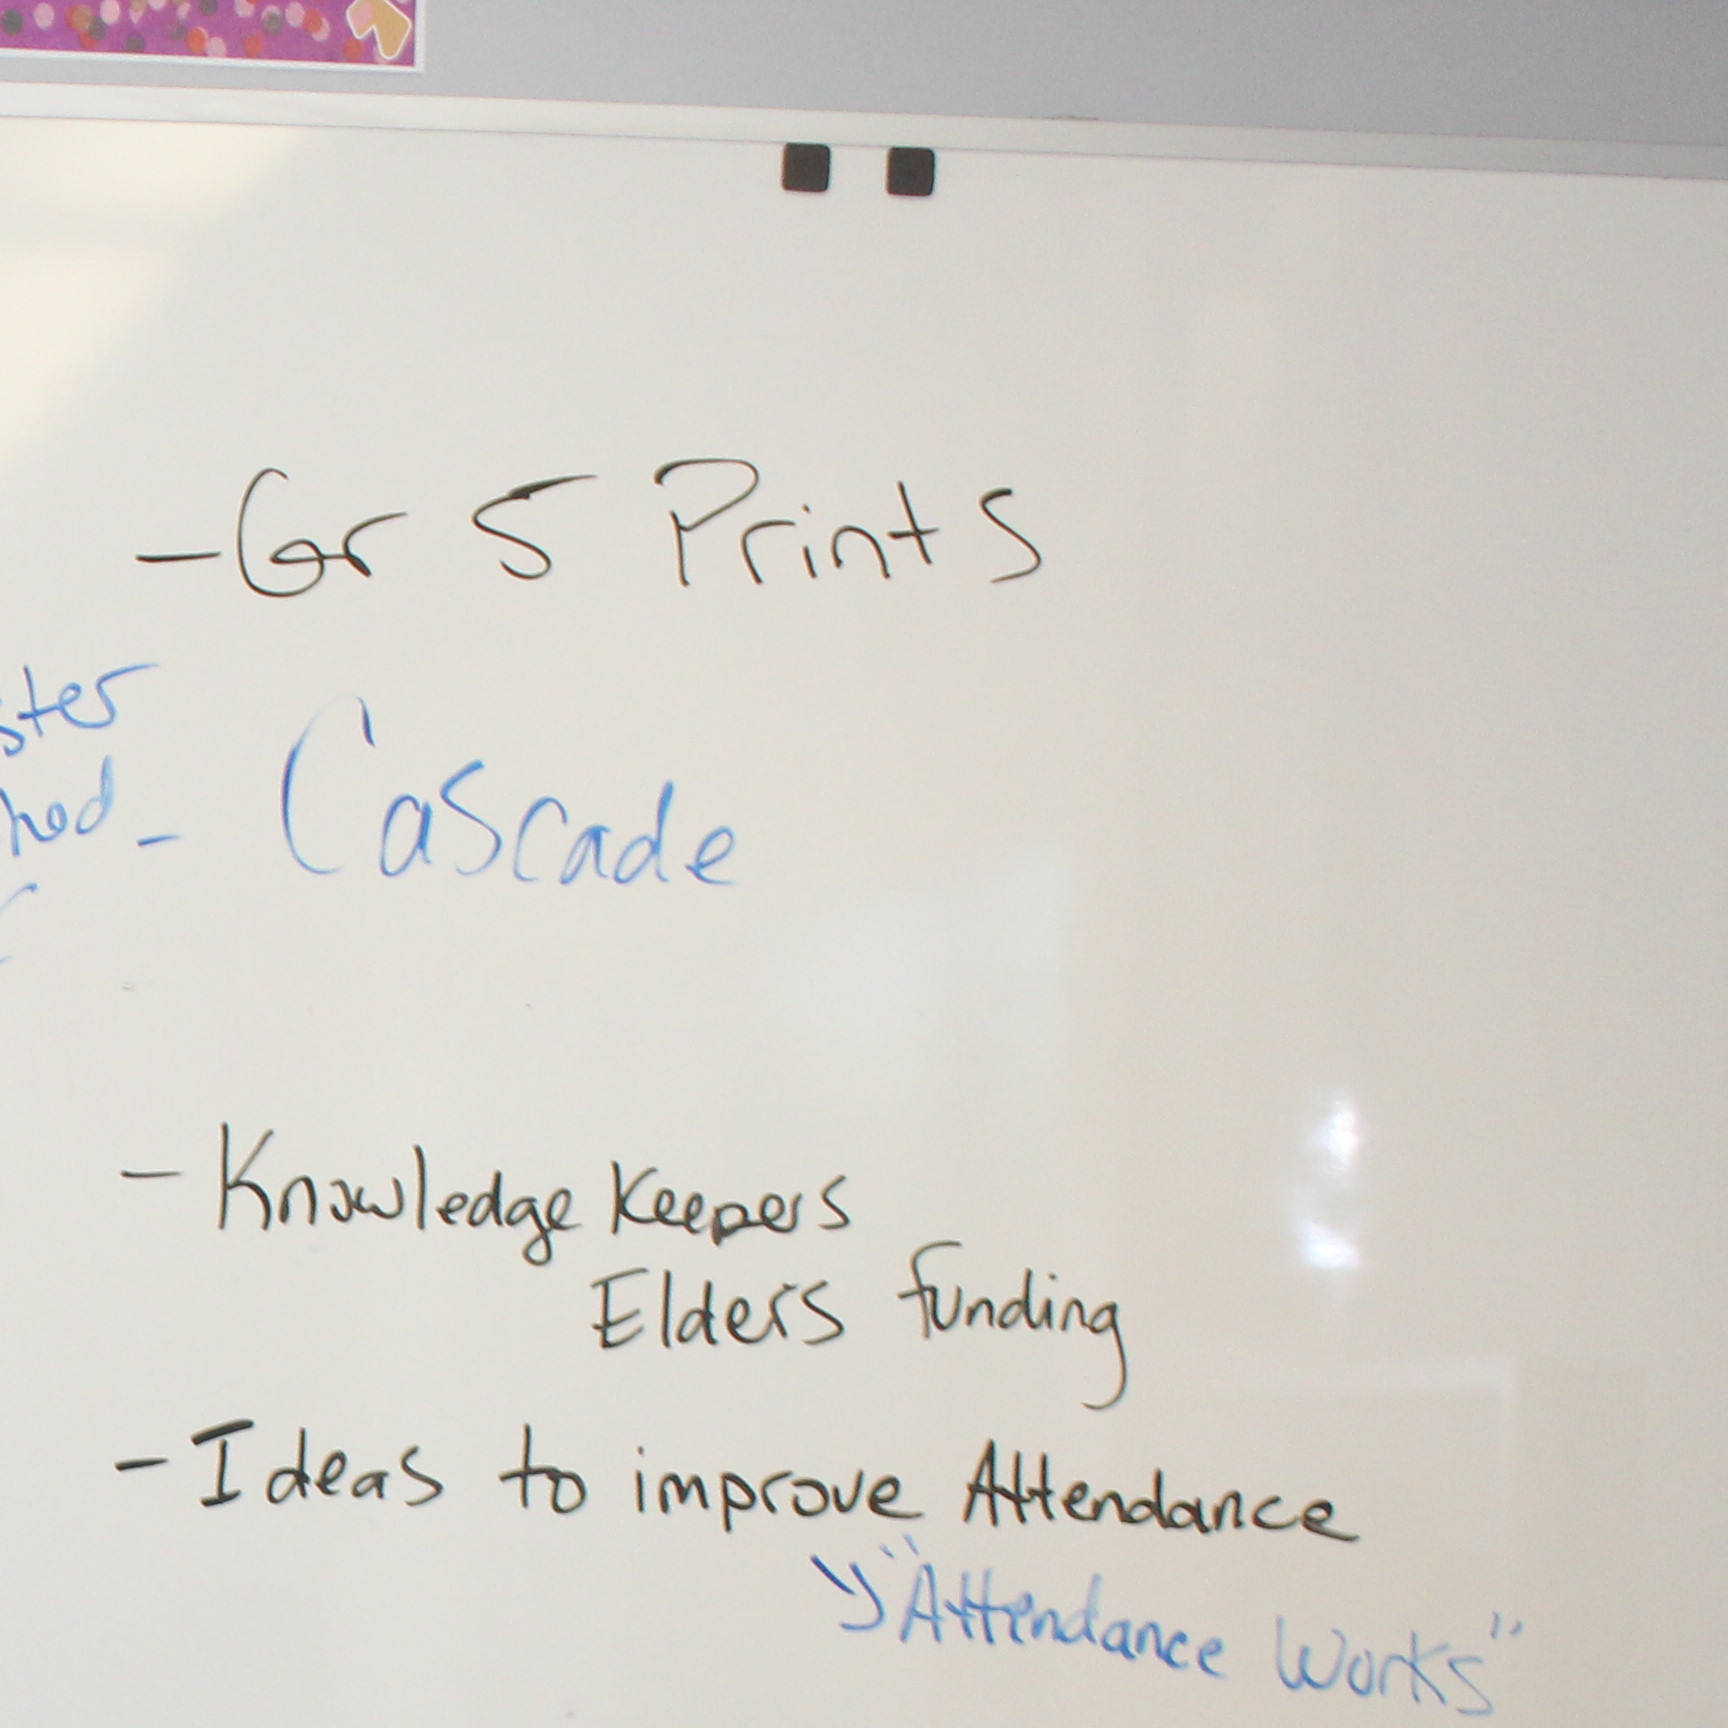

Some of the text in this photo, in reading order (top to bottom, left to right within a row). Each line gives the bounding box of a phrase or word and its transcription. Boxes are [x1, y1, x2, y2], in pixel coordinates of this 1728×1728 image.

[472, 476, 597, 579] 5
[656, 458, 1042, 586] Prints
[281, 695, 739, 887] Cascade
[591, 1270, 846, 1349] Elders
[499, 1424, 589, 1517] to
[632, 1446, 924, 1532] improve
[962, 1439, 1361, 1543] Attendance
